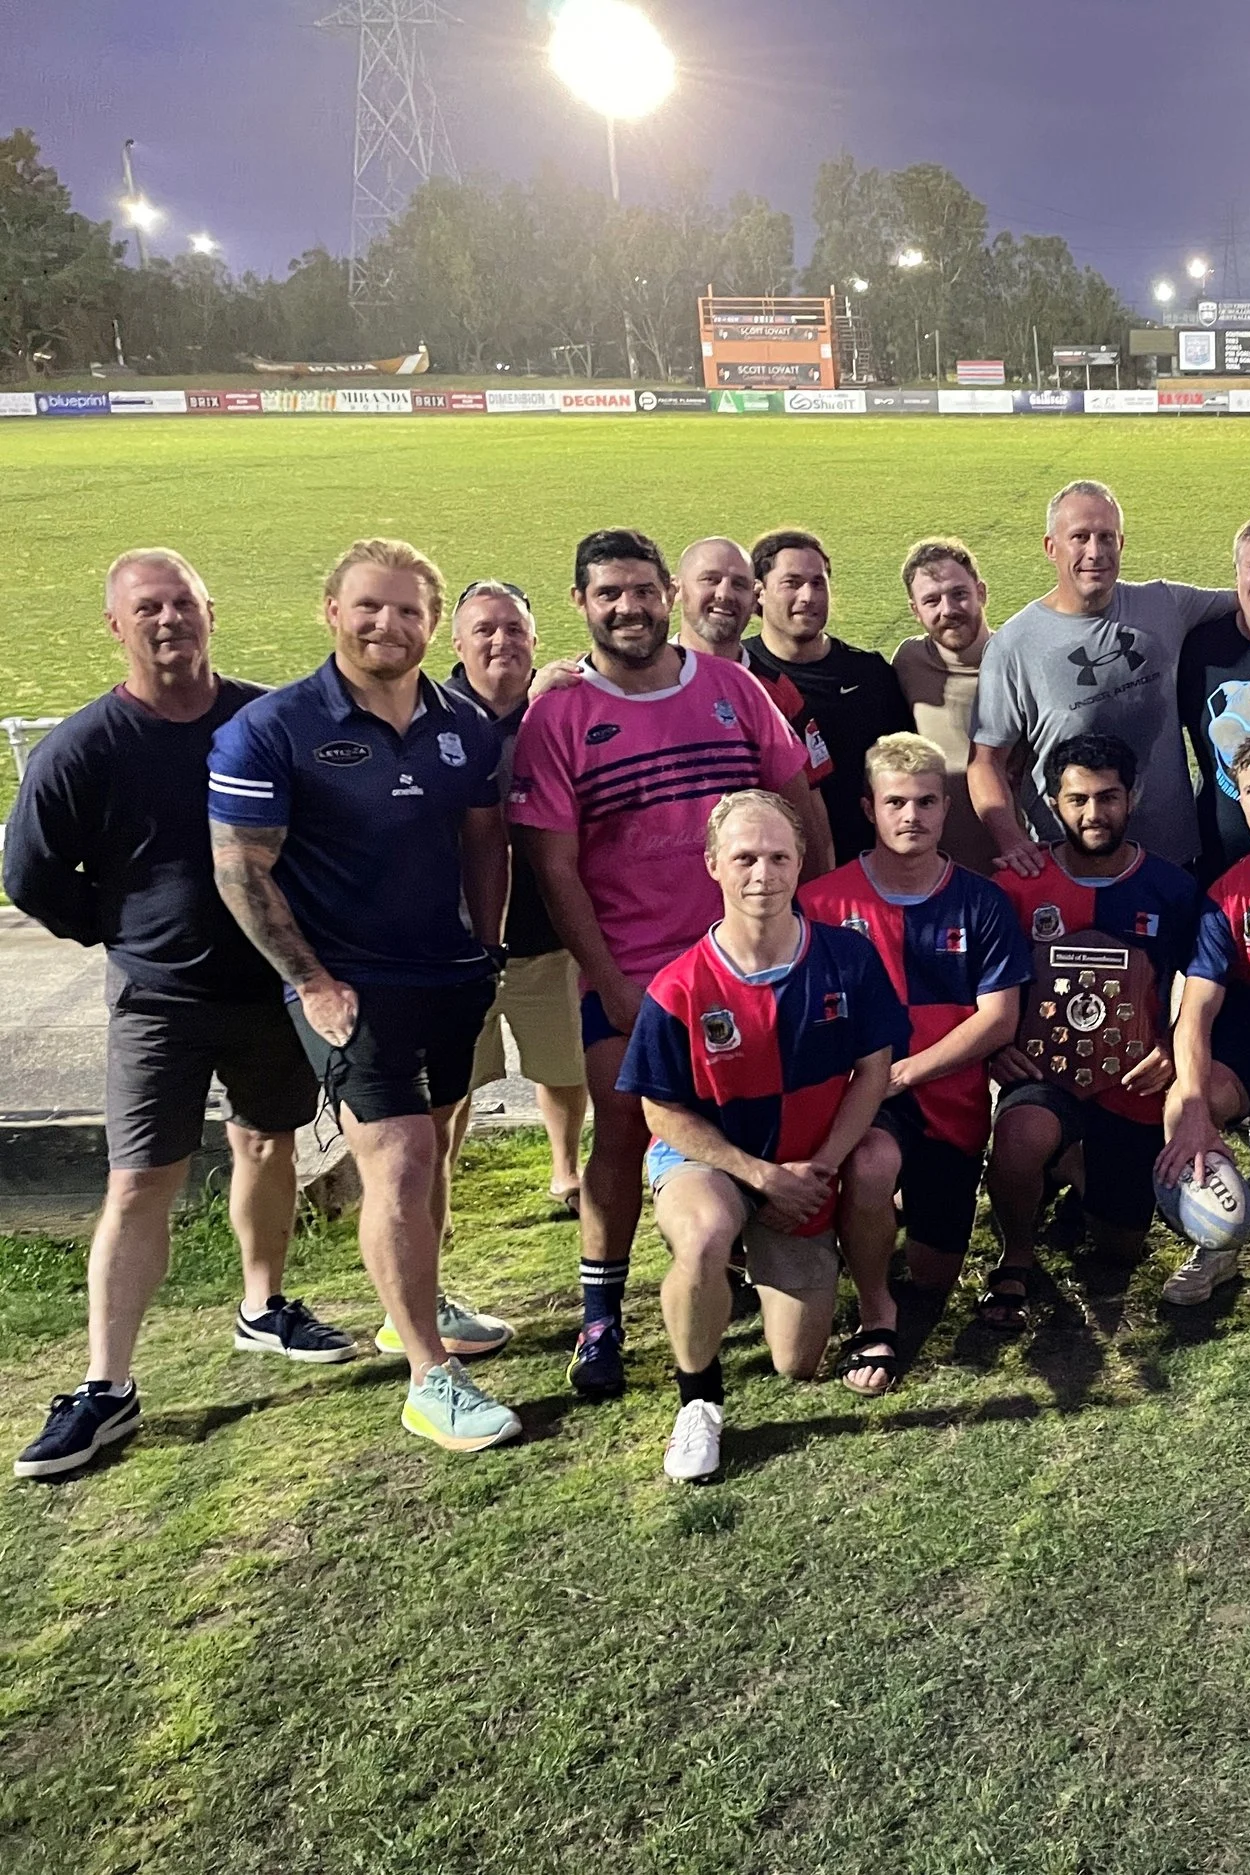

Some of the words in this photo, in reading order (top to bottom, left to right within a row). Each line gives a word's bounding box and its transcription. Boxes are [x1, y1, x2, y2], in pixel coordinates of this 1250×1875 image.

[740, 327, 764, 336] SCOTT
[737, 365, 765, 375] SCOTT
[768, 365, 800, 375] LOVATT
[48, 394, 107, 408] blueprint
[190, 397, 220, 408] BRIX
[341, 392, 409, 403] MIRANDA
[415, 395, 446, 407] BRIX
[488, 393, 546, 405] DIMENSION
[562, 394, 631, 407] DEGNAN
[1069, 691, 1112, 711] UNDER
[1113, 672, 1161, 696] ARMOUR
